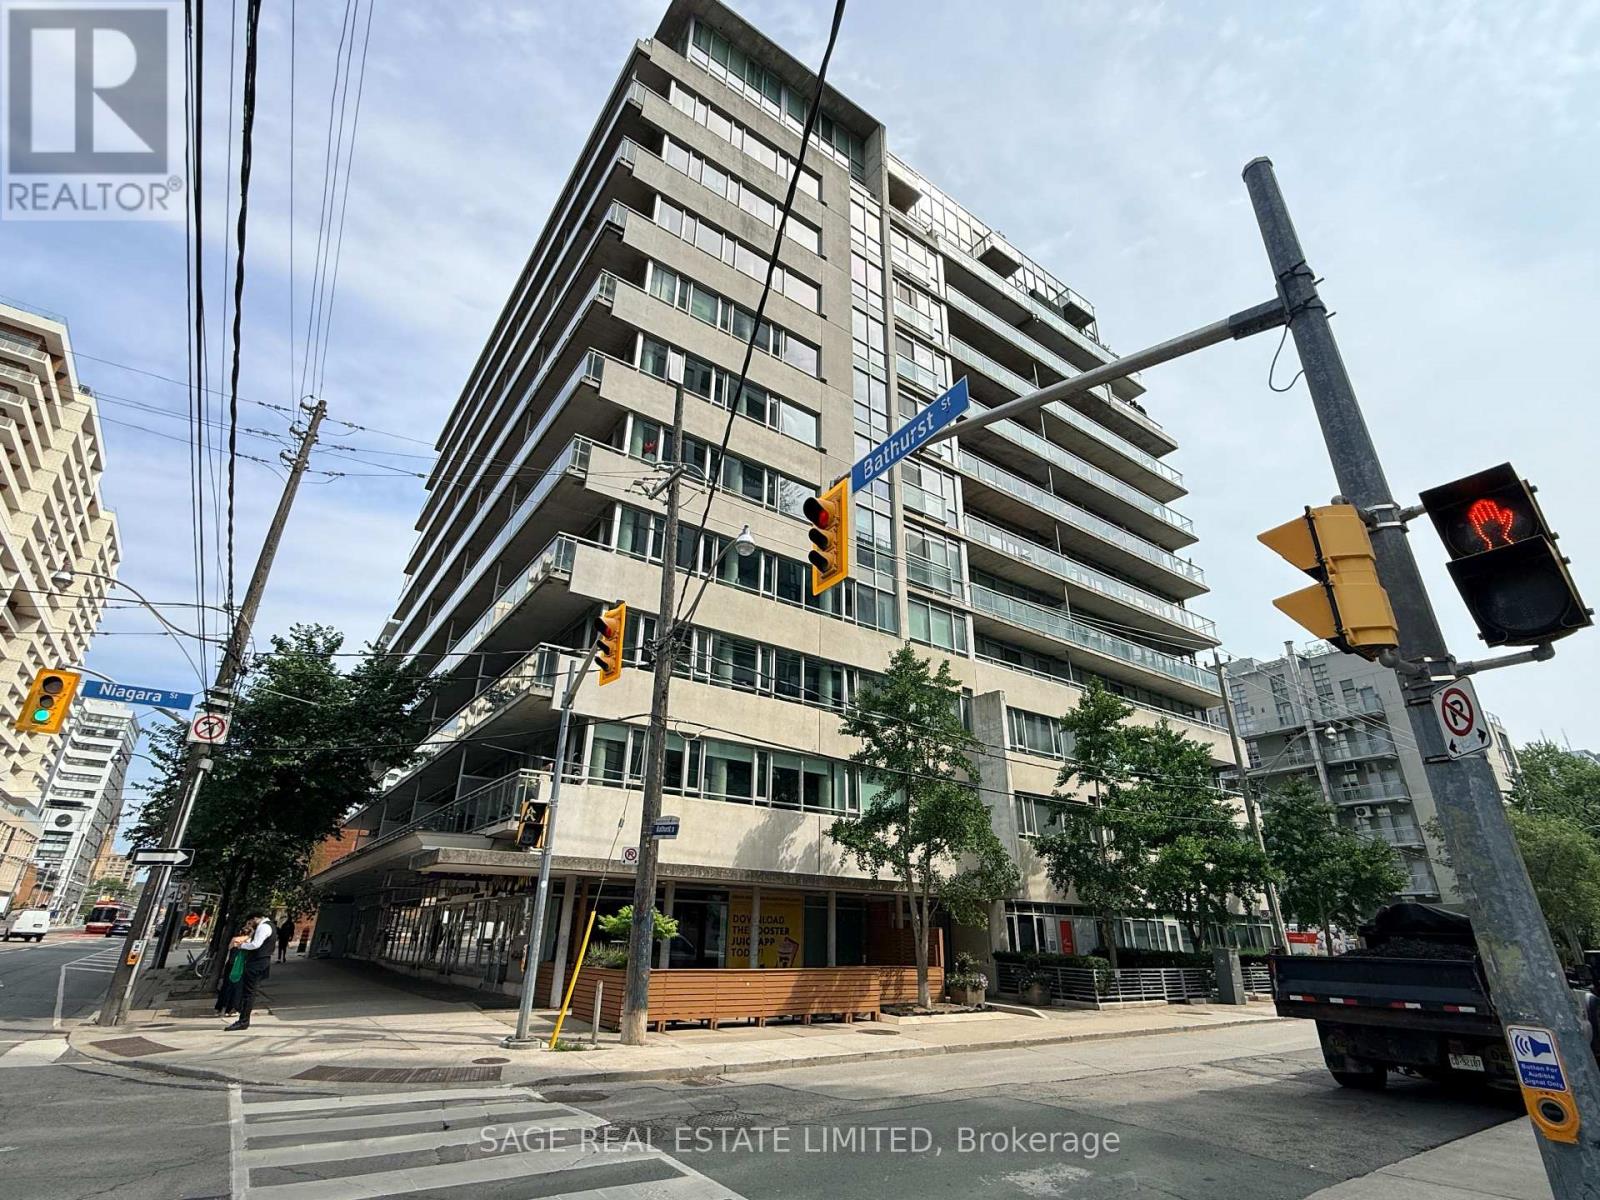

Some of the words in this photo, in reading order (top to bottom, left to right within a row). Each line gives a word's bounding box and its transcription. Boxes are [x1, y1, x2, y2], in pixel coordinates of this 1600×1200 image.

[863, 411, 934, 480] Bathurst
[940, 396, 951, 411] St
[99, 683, 162, 702] Niagara
[169, 691, 178, 700] St
[732, 926, 751, 935] THE
[757, 926, 790, 935] OSTER
[731, 936, 751, 946] JUIC
[731, 948, 764, 957] TOD!
[1521, 1063, 1545, 1071] Button
[1528, 1071, 1556, 1080] Audible
[1524, 1078, 1546, 1086] Signal
[1547, 1081, 1564, 1089] Only
